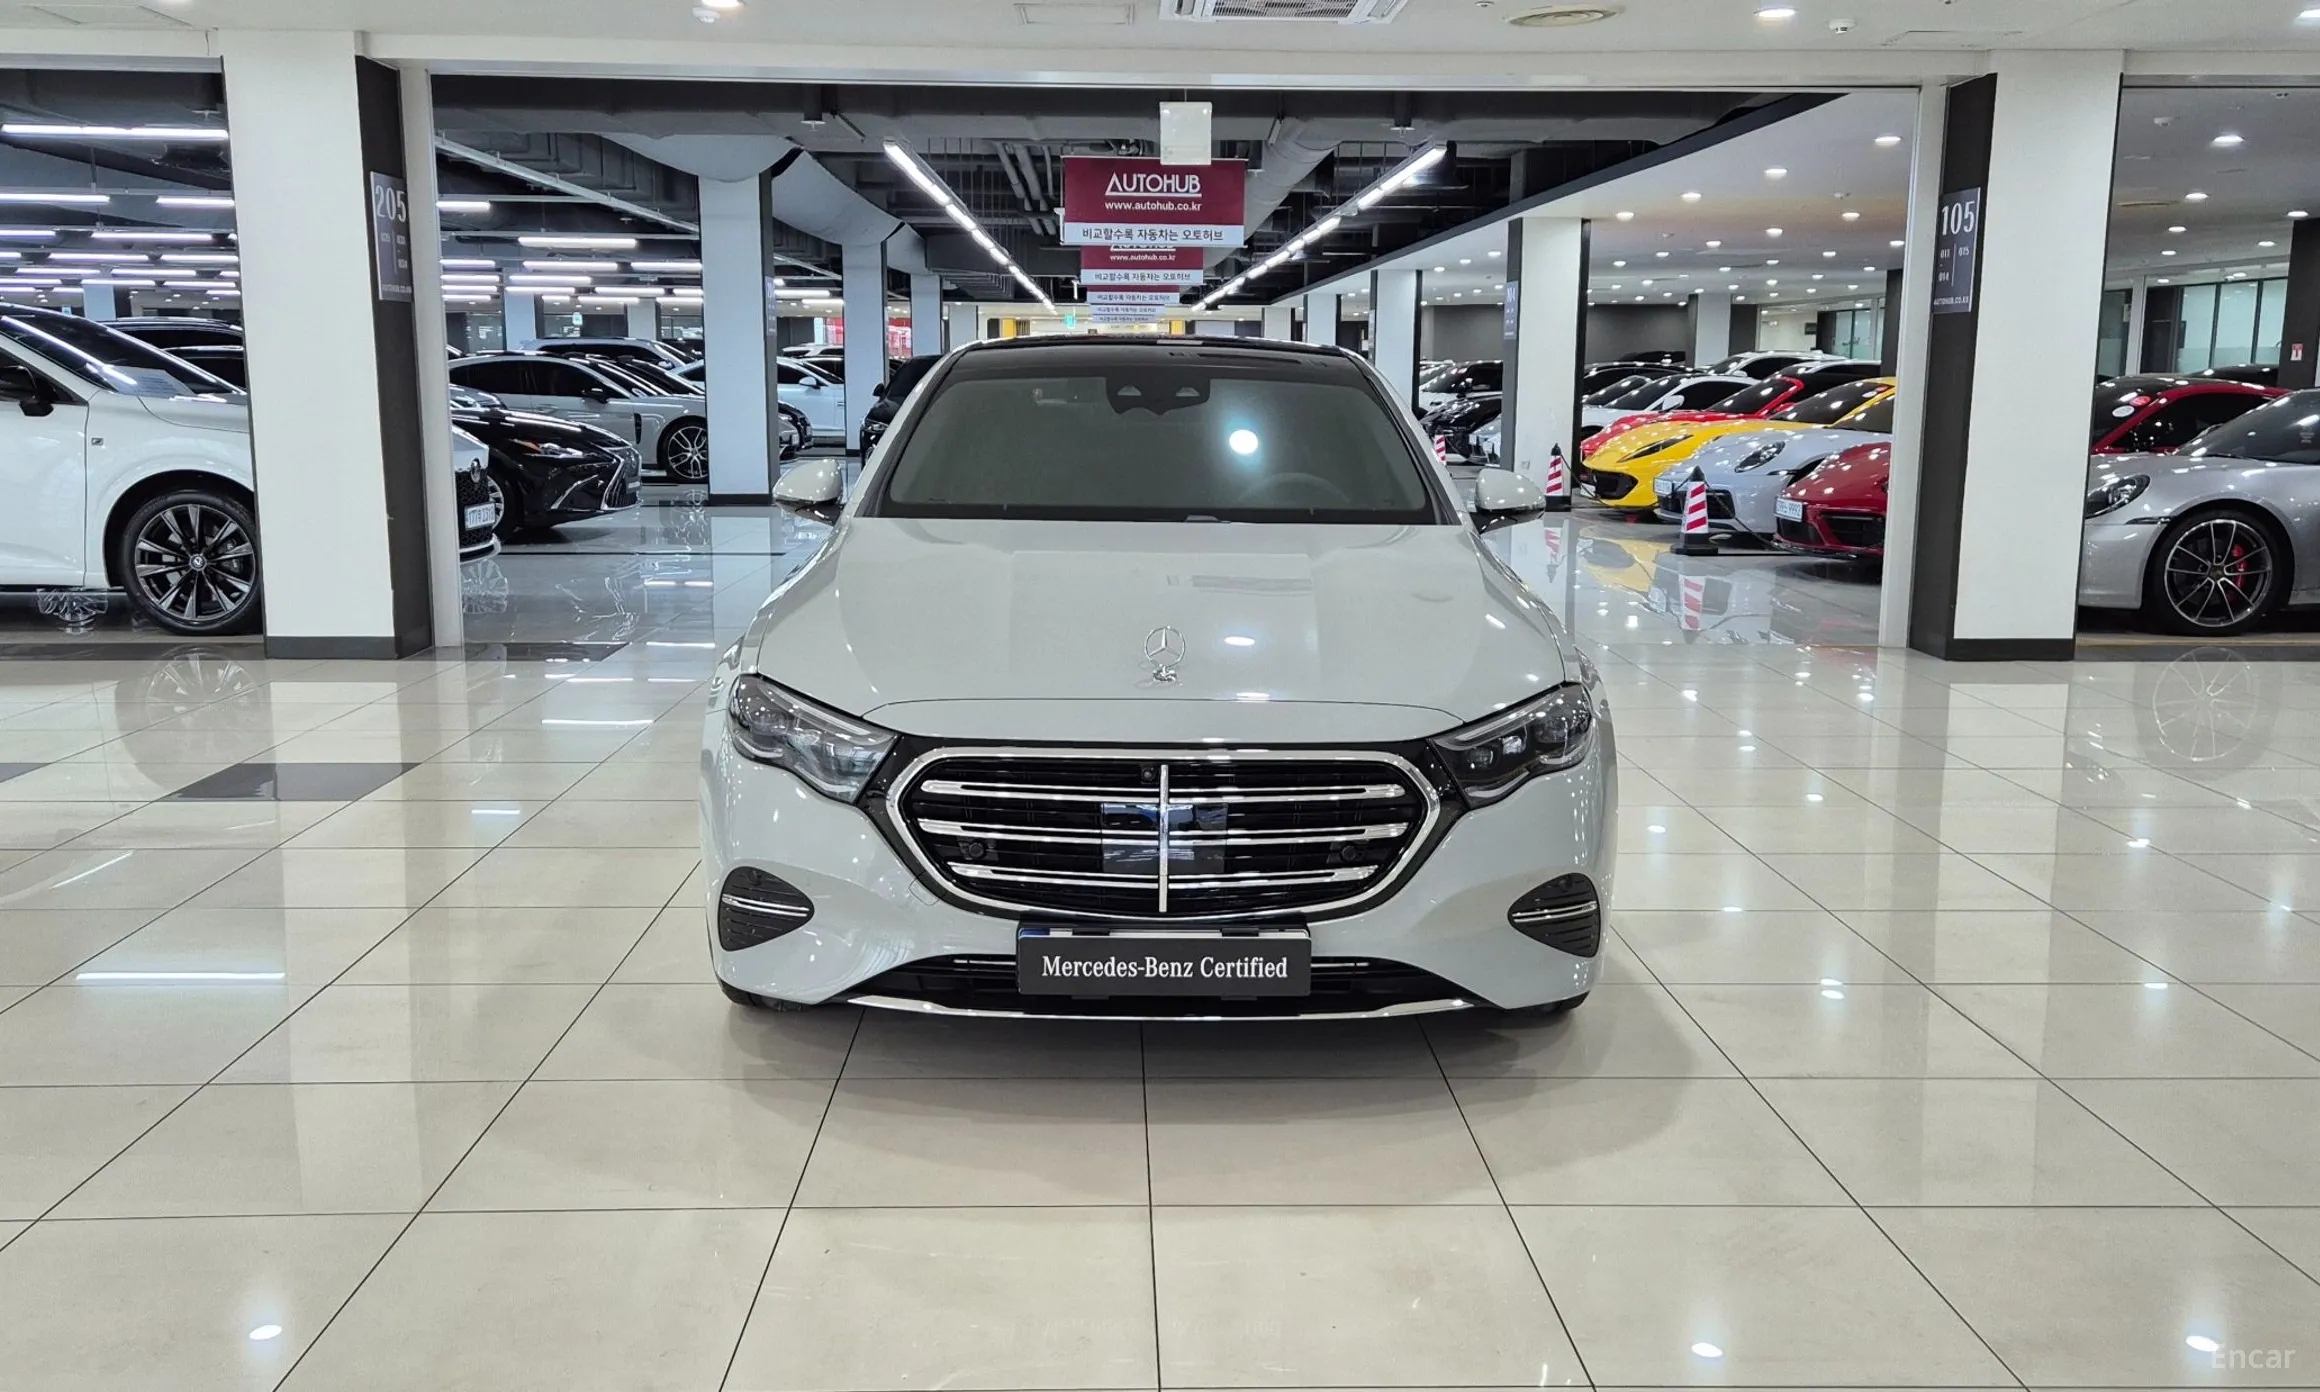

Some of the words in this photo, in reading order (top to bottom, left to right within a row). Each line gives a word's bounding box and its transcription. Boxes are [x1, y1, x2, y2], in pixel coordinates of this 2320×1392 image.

[1105, 172, 1202, 197] AUTOHUB
[375, 185, 407, 222] 205
[1105, 201, 1202, 211] www.autohub.co.kr
[1941, 200, 1975, 236] 105
[1082, 227, 1133, 241] 비교할수록
[1137, 228, 1178, 241] 자동차는
[1182, 229, 1224, 242] 오토허브
[1109, 254, 1176, 262] www.autohub.co.kr
[1041, 955, 1194, 978] Mercedes-Benz
[1200, 956, 1288, 979] Certified
